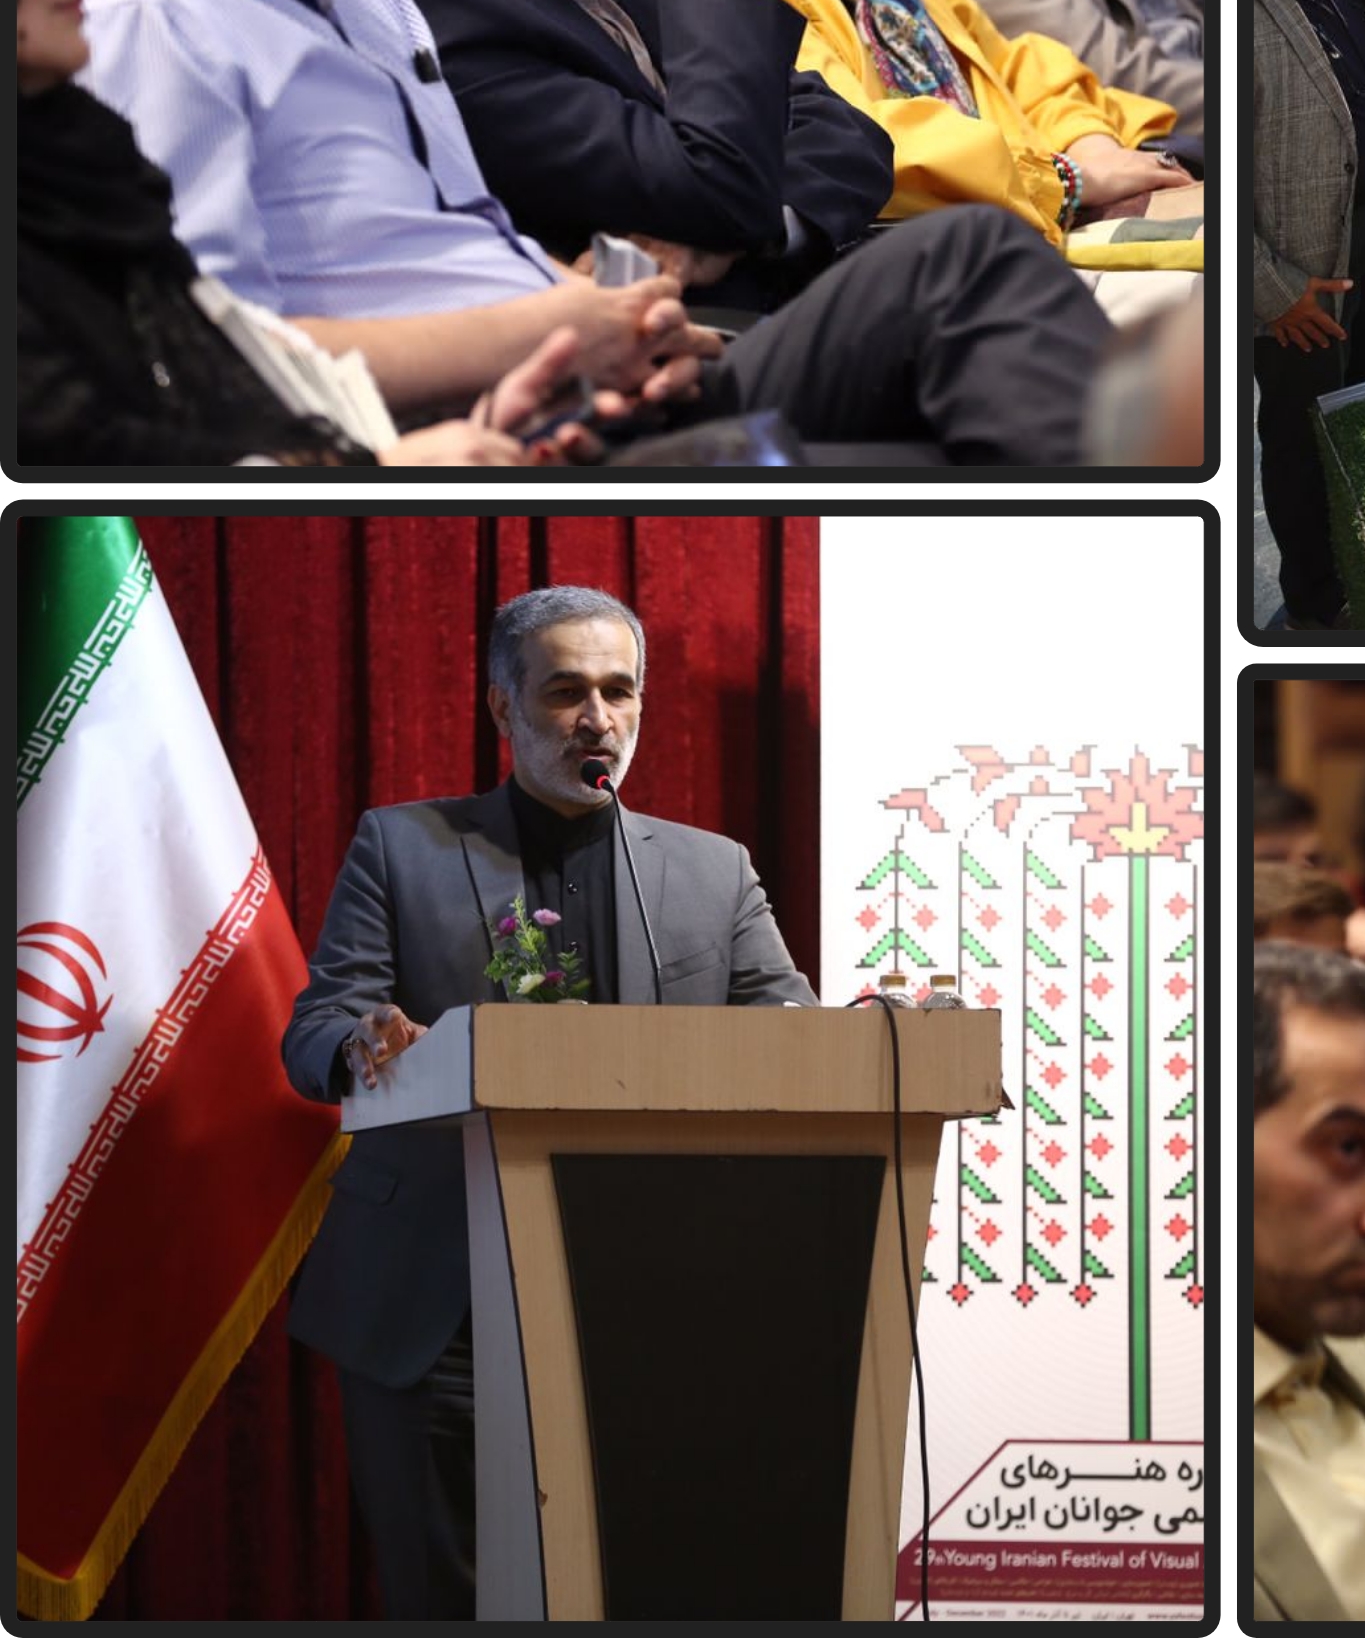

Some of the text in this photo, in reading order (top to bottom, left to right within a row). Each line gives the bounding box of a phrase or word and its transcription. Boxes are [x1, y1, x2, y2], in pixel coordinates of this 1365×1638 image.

[1000, 1453, 1167, 1490] هنرهای
[966, 1495, 1036, 1531] ایران
[1044, 1495, 1144, 1533] جوانان
[943, 1548, 997, 1571] Young
[1001, 1549, 1057, 1568] Iranian
[1061, 1549, 1124, 1569] Festival
[1128, 1551, 1147, 1569] of
[1149, 1551, 1200, 1571] Visual
